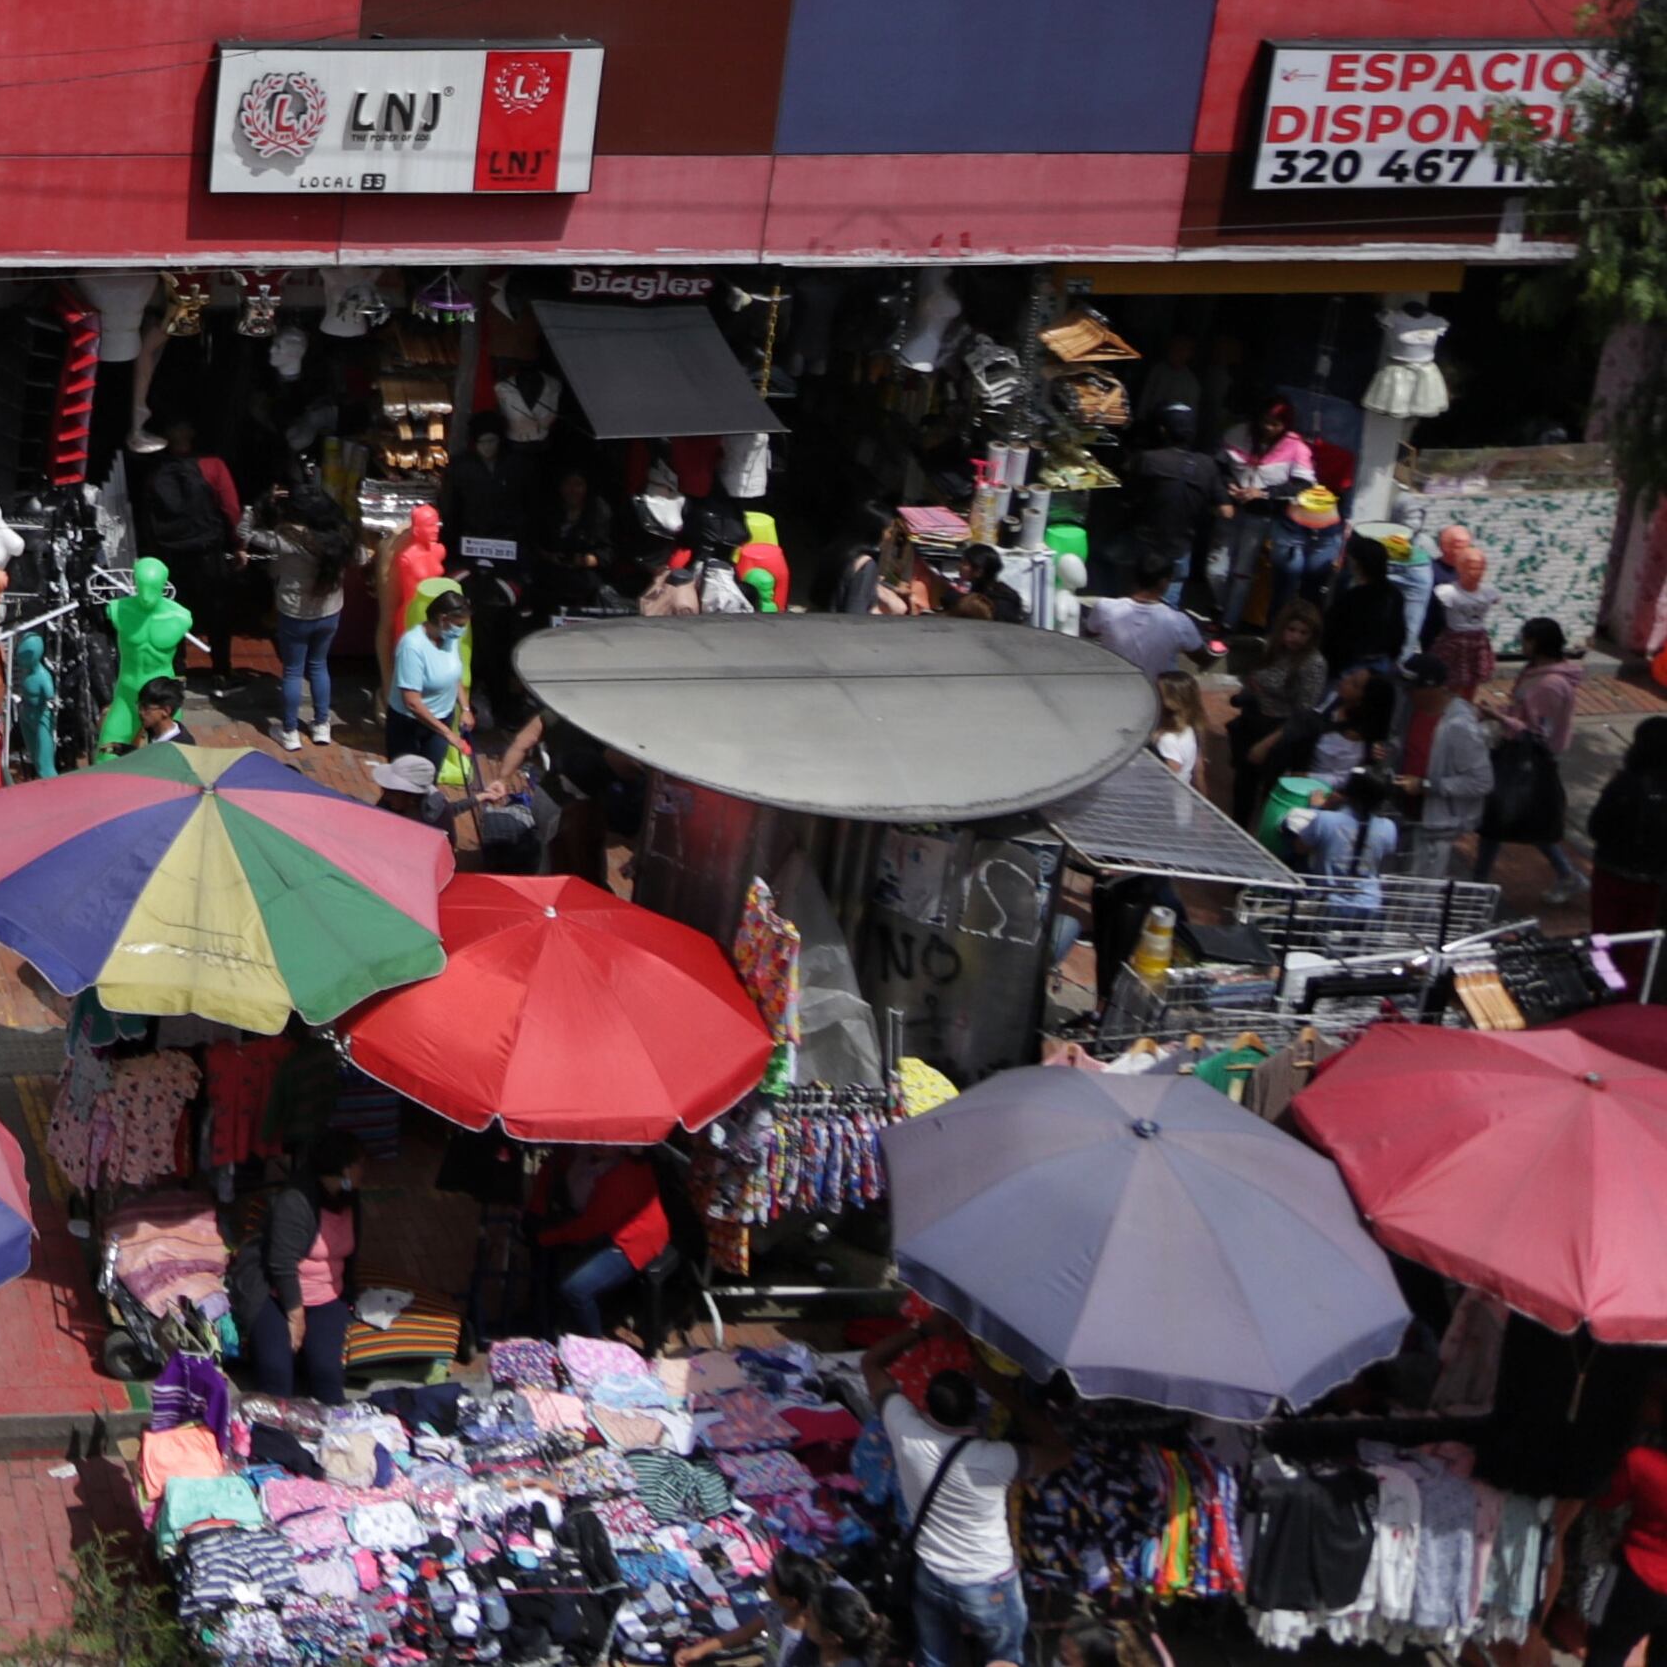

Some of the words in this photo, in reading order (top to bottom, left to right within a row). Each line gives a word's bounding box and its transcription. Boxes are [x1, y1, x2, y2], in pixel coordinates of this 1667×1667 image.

[514, 74, 530, 100] L
[1325, 52, 1587, 93] ESPACIO
[275, 96, 295, 133] L
[351, 88, 442, 132] LNJ
[489, 150, 543, 175] LNJ
[1269, 149, 1362, 185] 320
[1378, 149, 1477, 185] 467
[299, 177, 355, 189] LOCAL
[571, 269, 712, 300] Diagler
